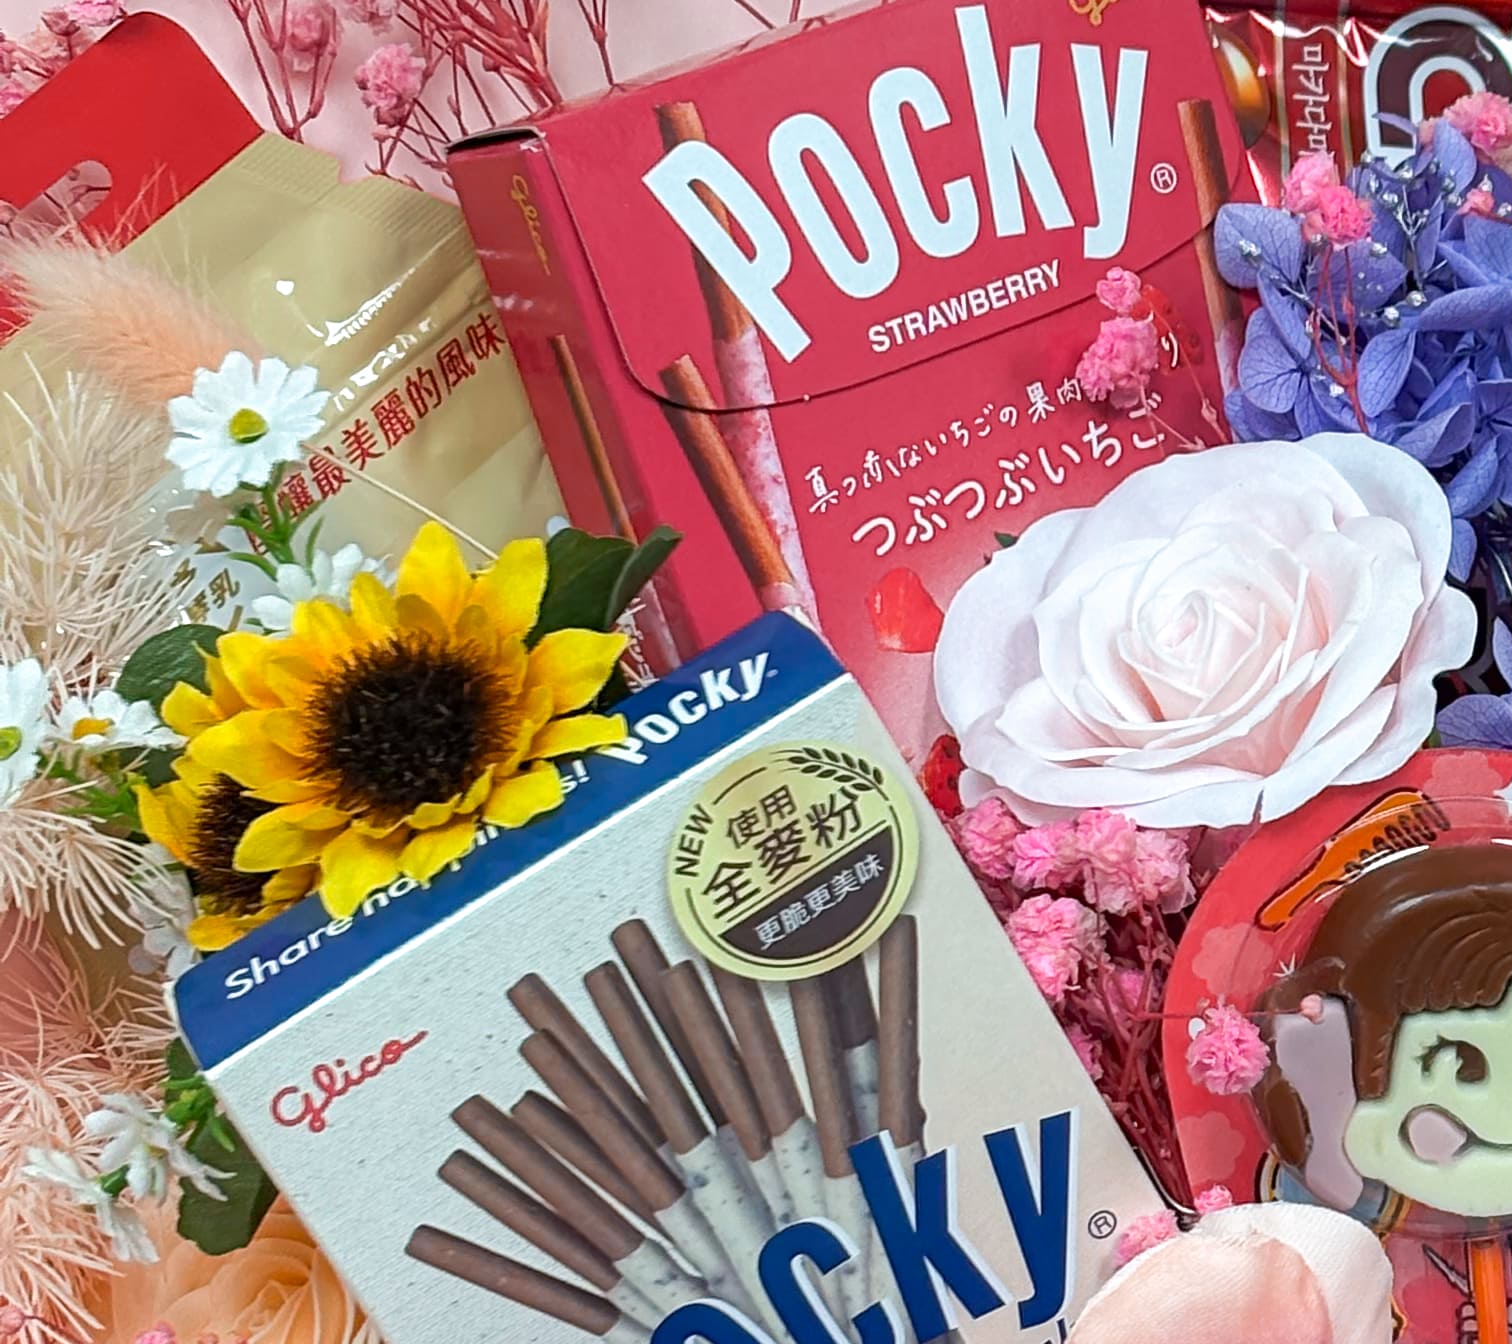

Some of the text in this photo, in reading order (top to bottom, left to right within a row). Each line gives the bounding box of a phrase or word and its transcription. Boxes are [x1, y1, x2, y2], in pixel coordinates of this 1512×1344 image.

[1291, 42, 1336, 158] 마카다미
[642, 3, 1150, 364] Pocky
[868, 259, 1063, 354] STRAWBERRY
[851, 391, 1166, 558] つぶつぶいちご
[675, 803, 715, 879] NEW
[701, 785, 863, 920] 全麥粉
[727, 783, 799, 851] 使用
[753, 853, 885, 952] 更脆更美味
[224, 913, 354, 1000] Share
[270, 1028, 429, 1133] Glico
